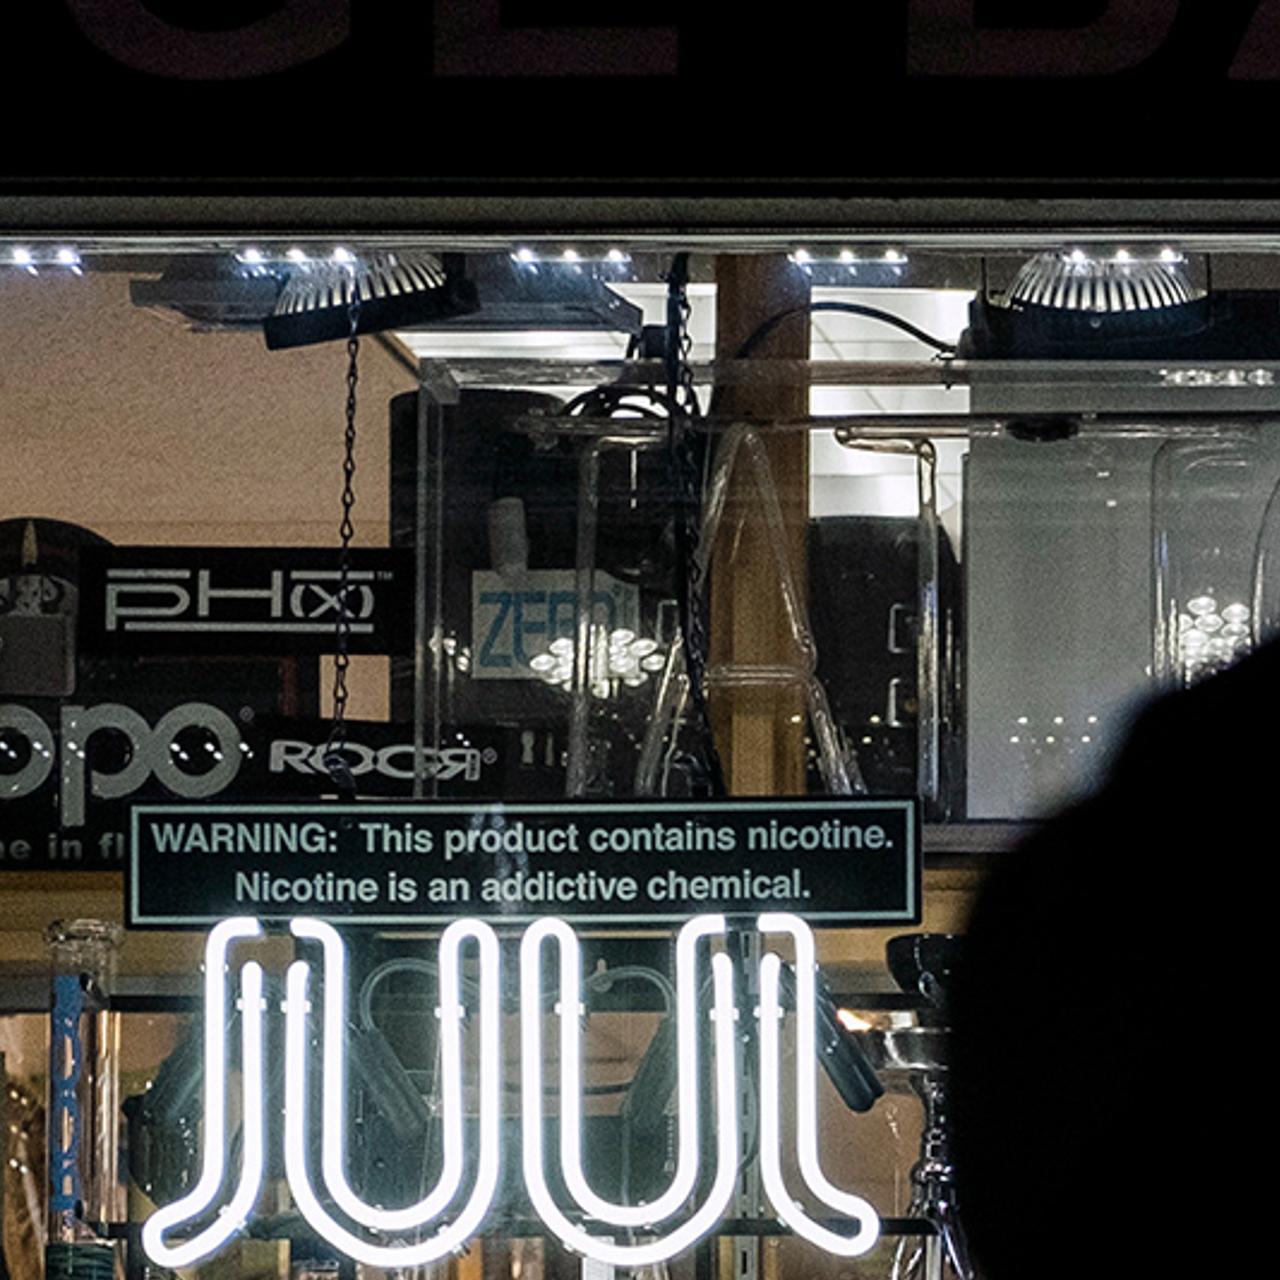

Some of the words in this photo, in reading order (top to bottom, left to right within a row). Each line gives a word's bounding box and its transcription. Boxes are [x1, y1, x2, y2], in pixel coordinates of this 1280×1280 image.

[47, 832, 84, 860] in
[151, 822, 338, 853] WARNING:
[358, 822, 433, 853] This
[444, 821, 579, 861] product
[589, 820, 737, 852] contains
[747, 819, 894, 850] nicotine.
[235, 871, 379, 902] Nicotine
[388, 871, 419, 902] is
[428, 879, 469, 902] an
[480, 870, 638, 902] addictive
[647, 868, 812, 900] chemical.
[141, 916, 882, 1268] JUUL
